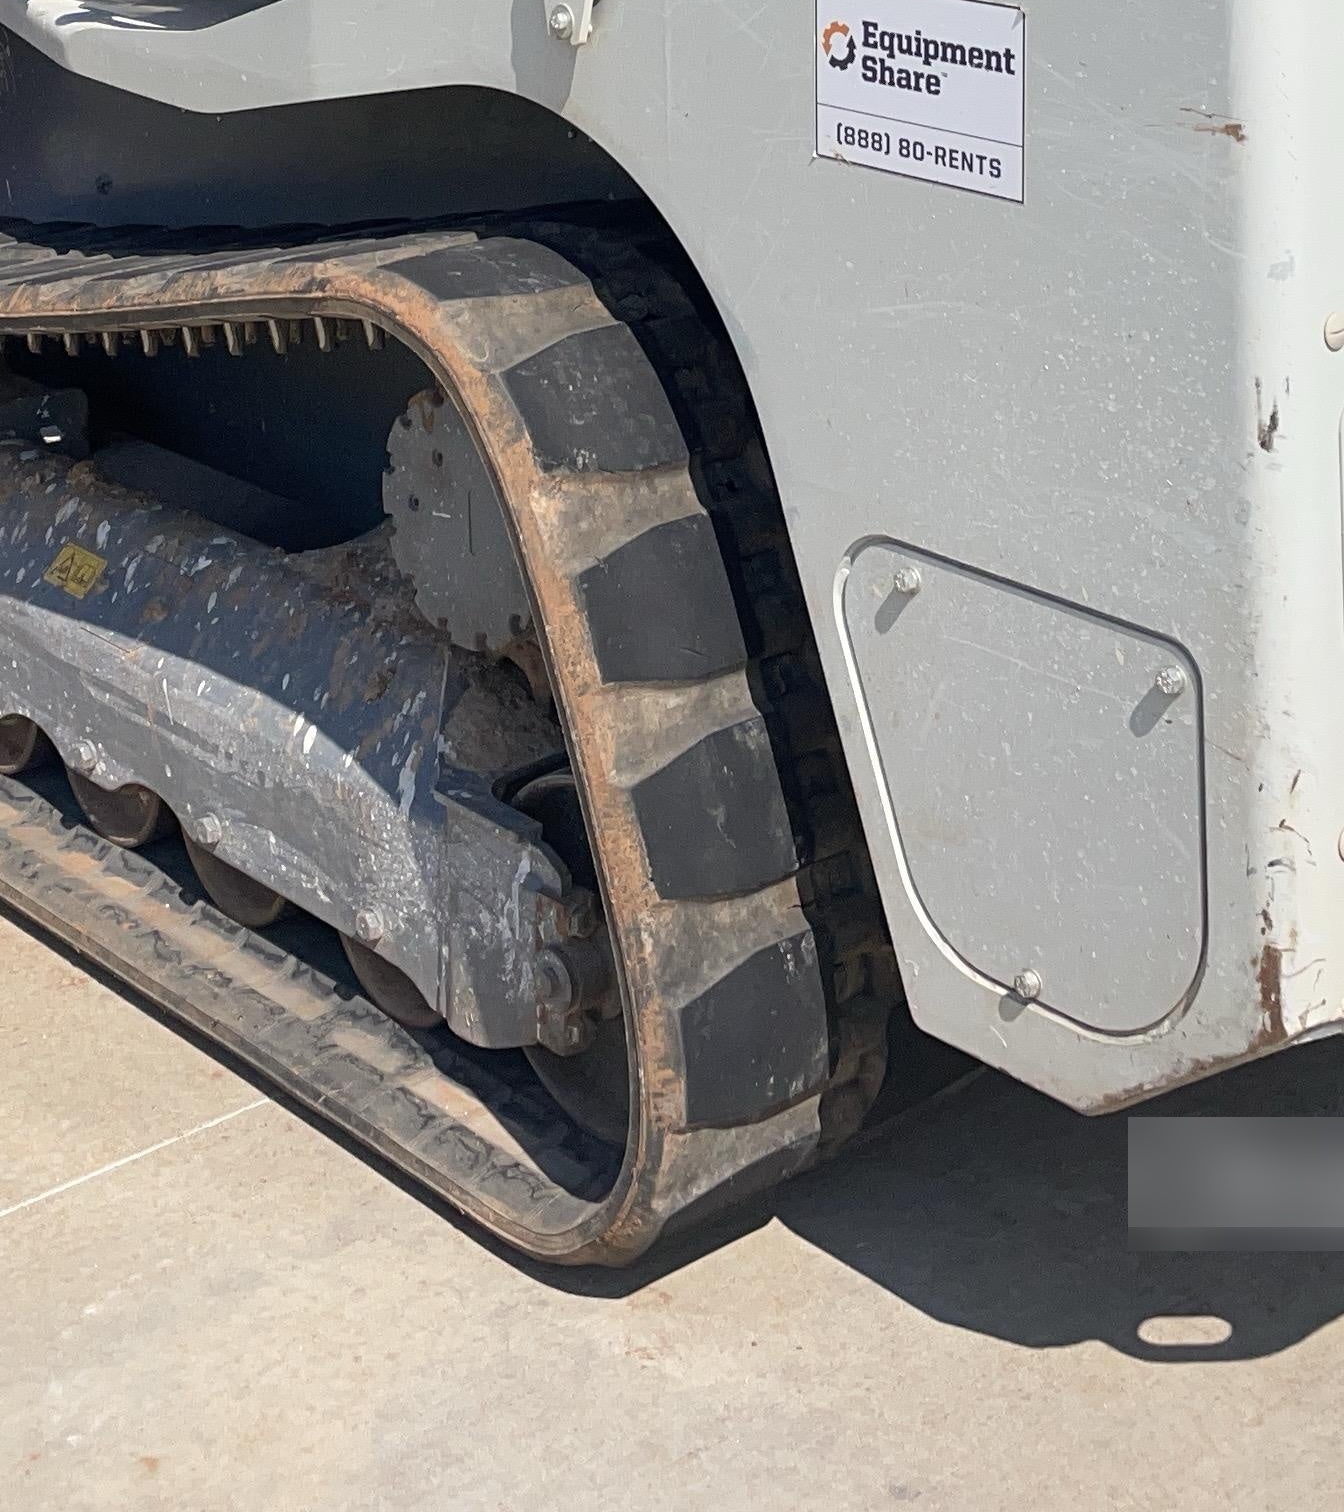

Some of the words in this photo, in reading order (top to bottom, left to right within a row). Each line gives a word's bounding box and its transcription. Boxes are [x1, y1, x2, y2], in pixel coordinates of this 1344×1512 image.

[861, 19, 1016, 76] Equipment
[861, 54, 942, 96] Share
[836, 122, 891, 156] (888)
[898, 138, 1002, 179] 80-RENTS
